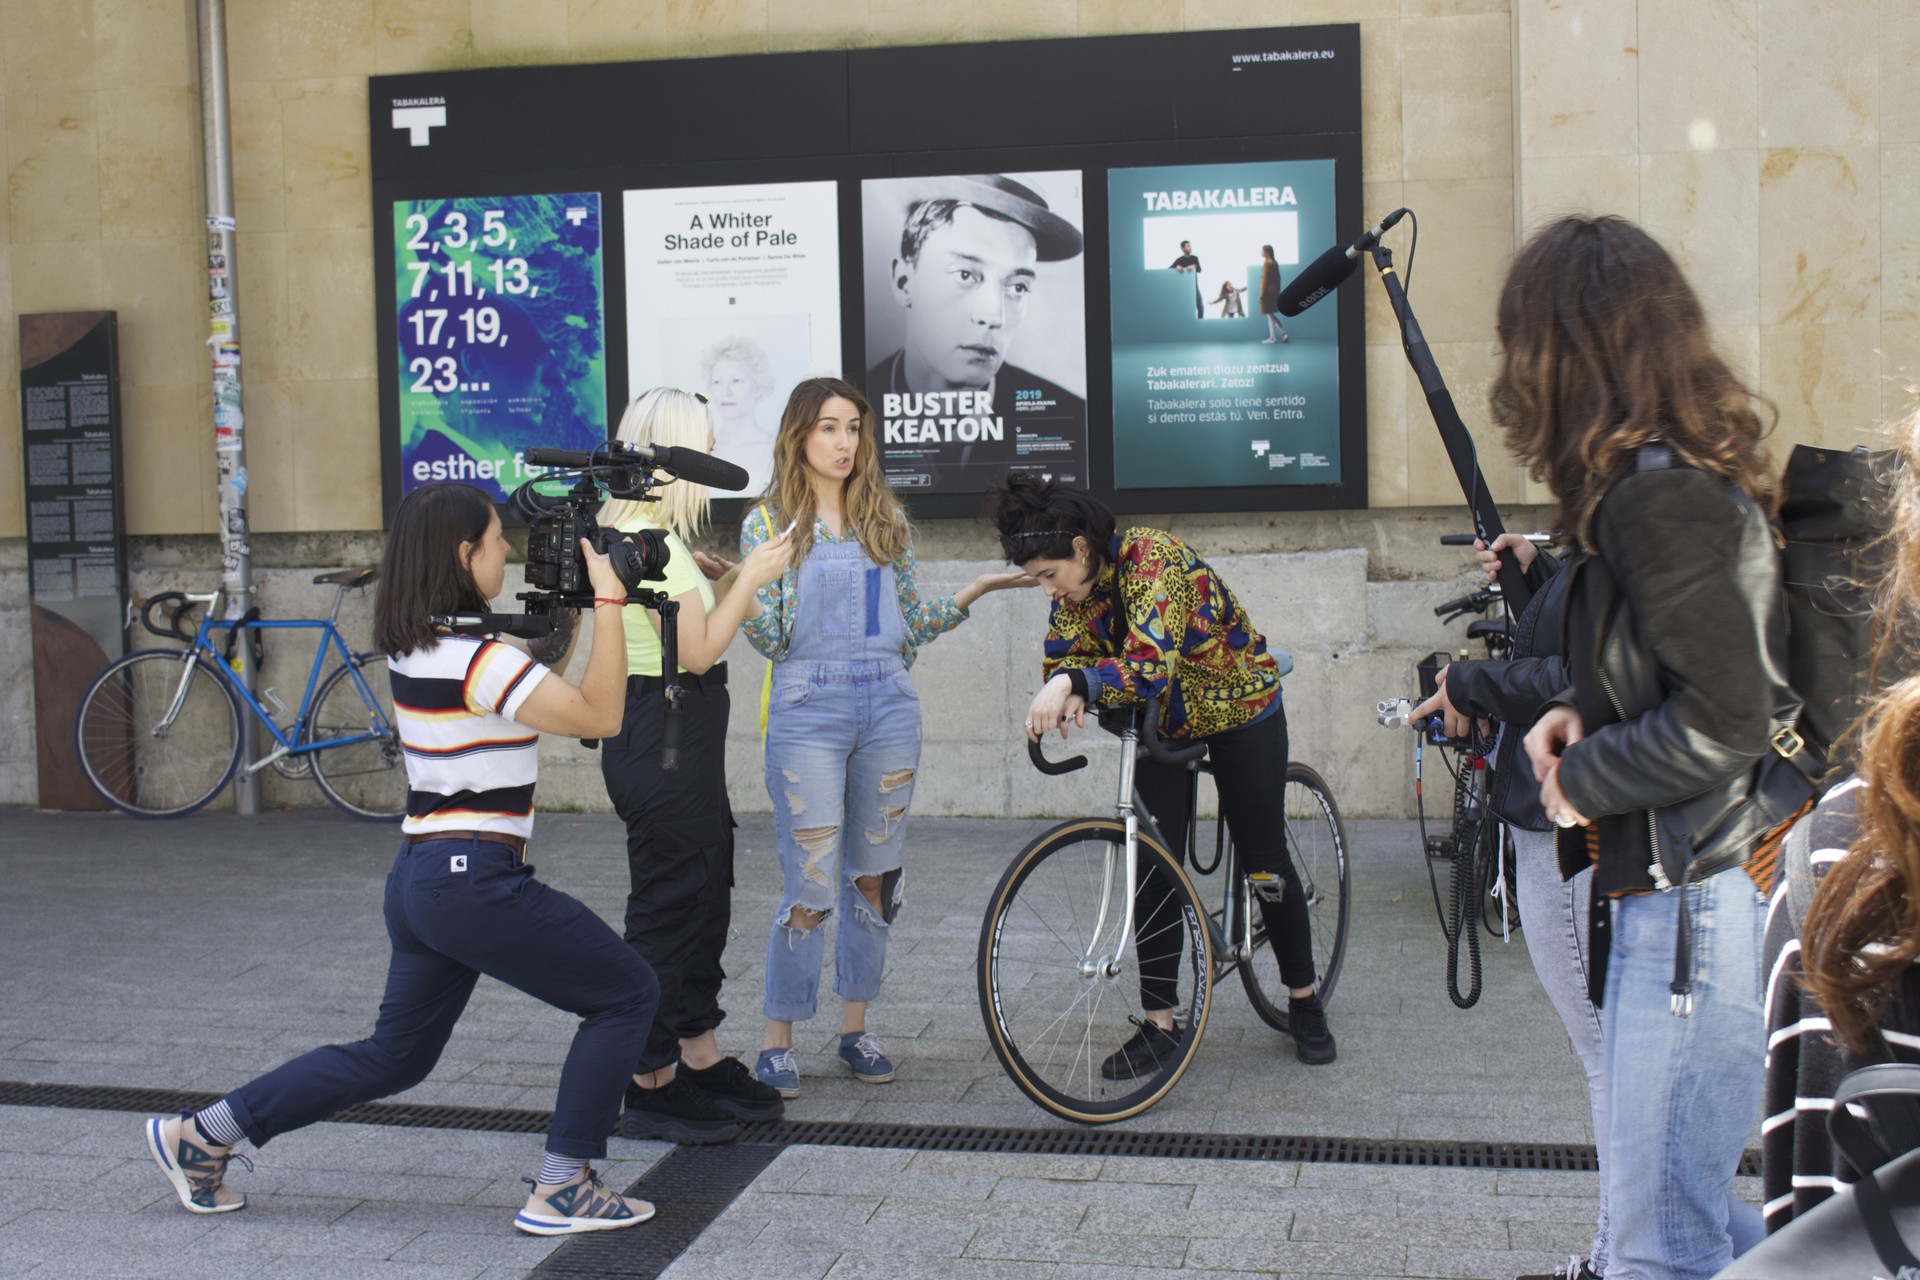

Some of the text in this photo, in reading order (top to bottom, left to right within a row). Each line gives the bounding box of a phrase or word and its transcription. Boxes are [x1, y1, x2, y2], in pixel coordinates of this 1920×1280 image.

[1232, 49, 1334, 63] www.tabakalera.eu
[392, 96, 446, 107] TABAKALERA
[1143, 185, 1297, 211] TABAKALERA
[690, 212, 773, 230] A Whiter
[664, 230, 797, 250] Shade of Pale
[409, 356, 490, 393] 23...
[1147, 363, 1290, 377] Zuk ematen diozu zentzua
[1147, 377, 1255, 390] Tabakalerari. Zatoz!
[1015, 390, 1042, 400] 2019
[1148, 395, 1306, 410] Tabakalera solo tiene sentido
[883, 391, 994, 417] BUSTER
[1148, 409, 1306, 423] si dentro estás tú. Ven. Entra.
[884, 417, 1004, 444] KEATON
[412, 453, 505, 481] esther
